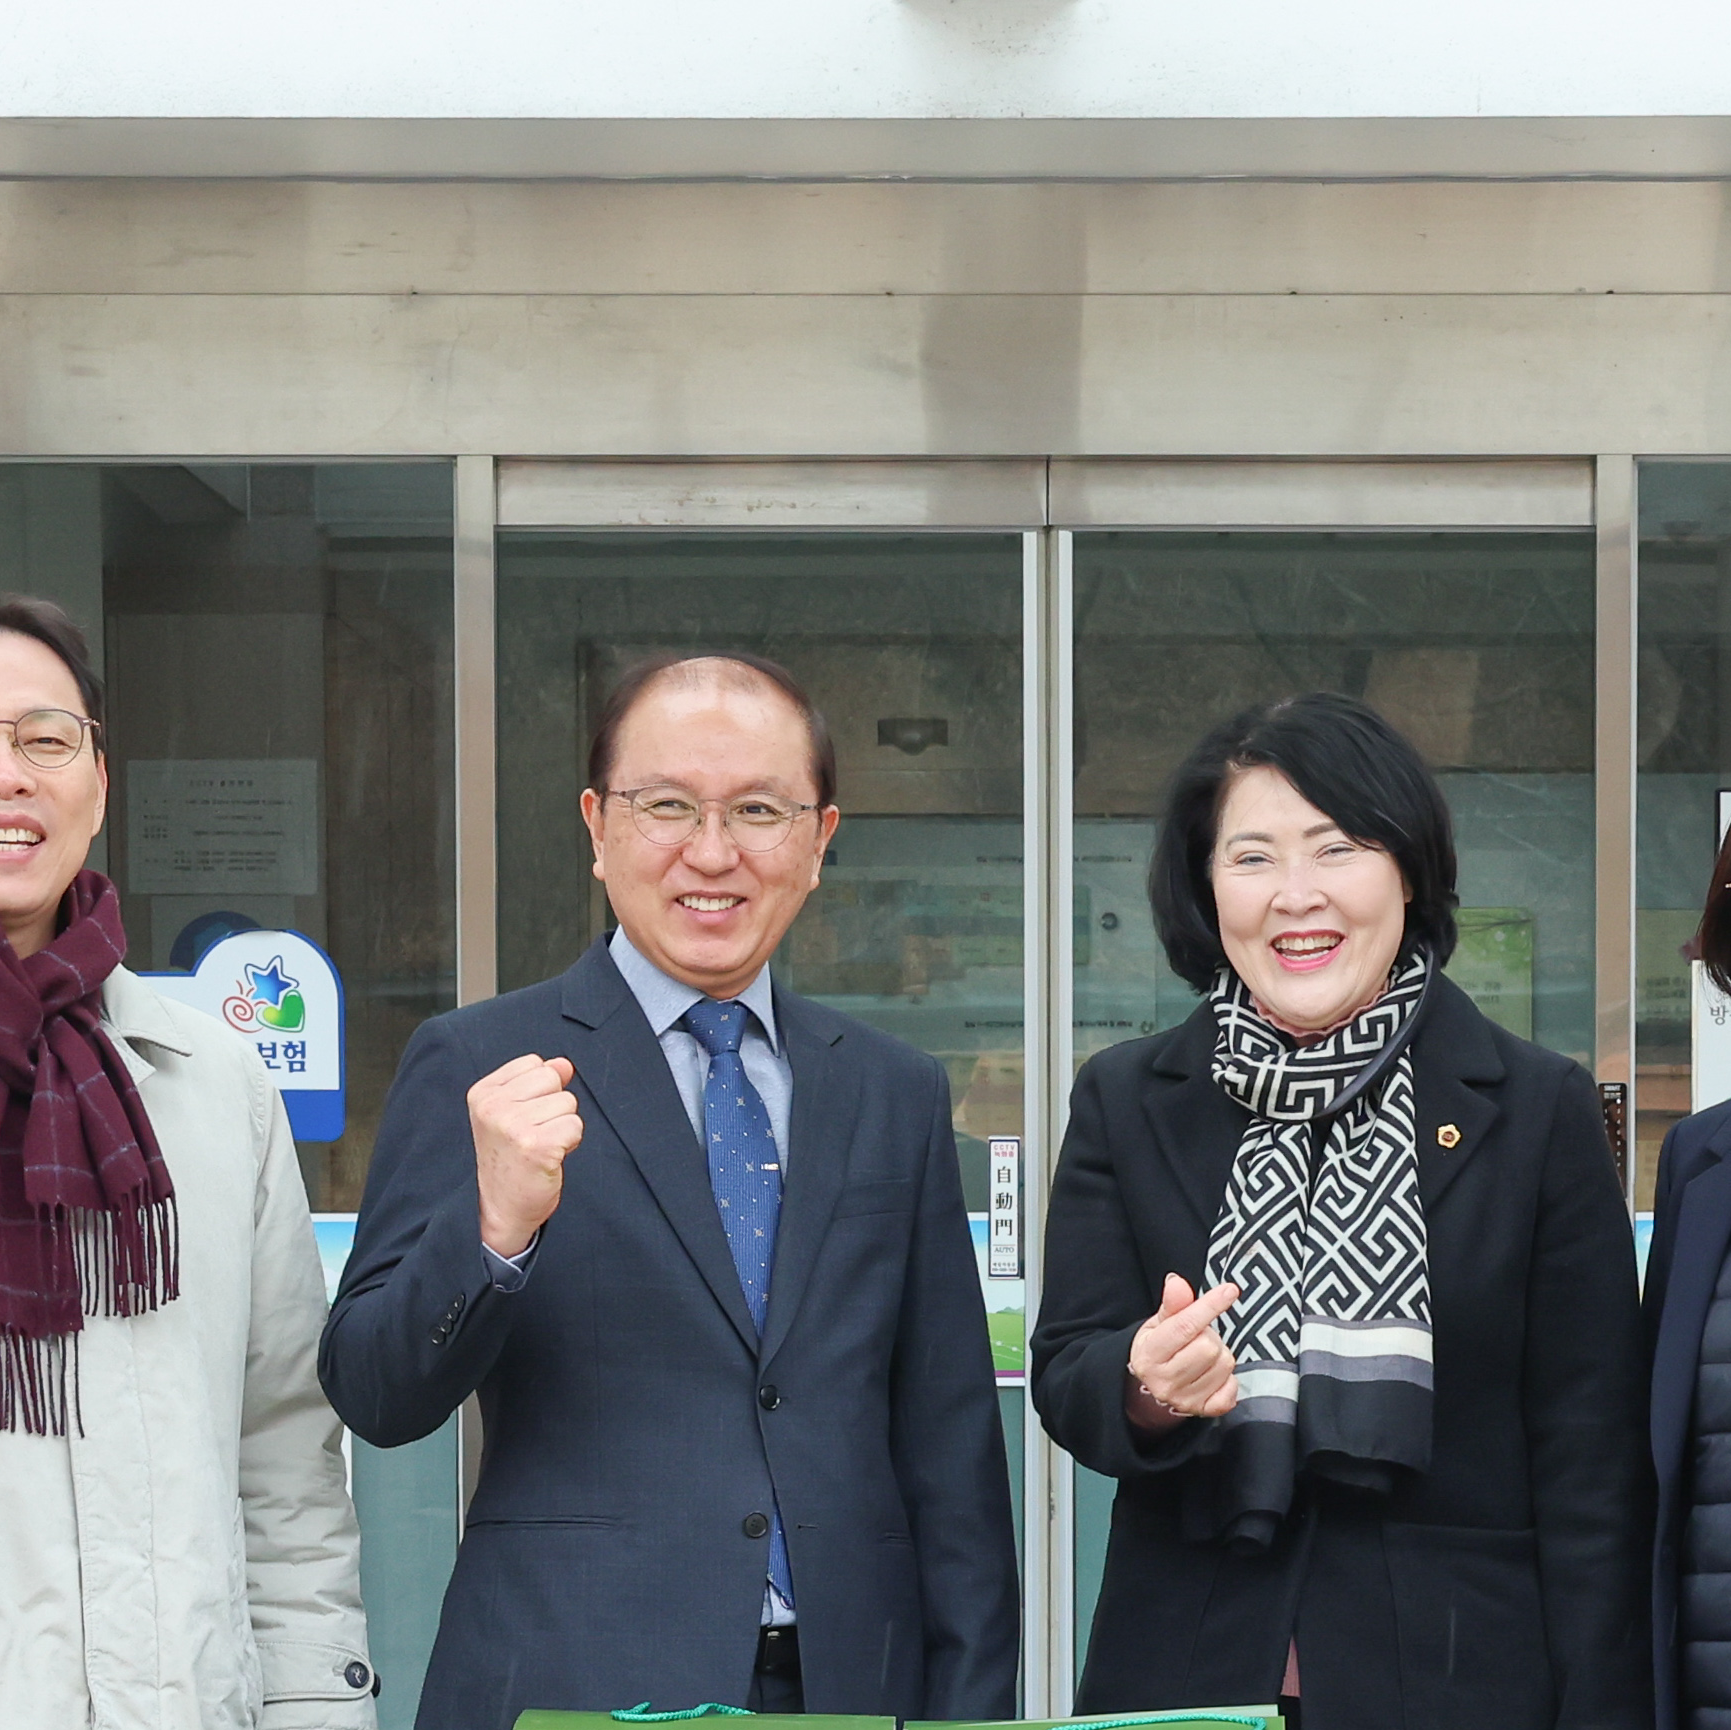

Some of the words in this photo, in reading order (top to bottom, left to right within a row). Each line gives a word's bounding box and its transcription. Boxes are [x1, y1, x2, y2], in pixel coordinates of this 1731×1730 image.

[256, 1040, 307, 1073] 보험
[995, 1166, 1013, 1236] 自動門
[994, 1246, 1015, 1254] AUTO
